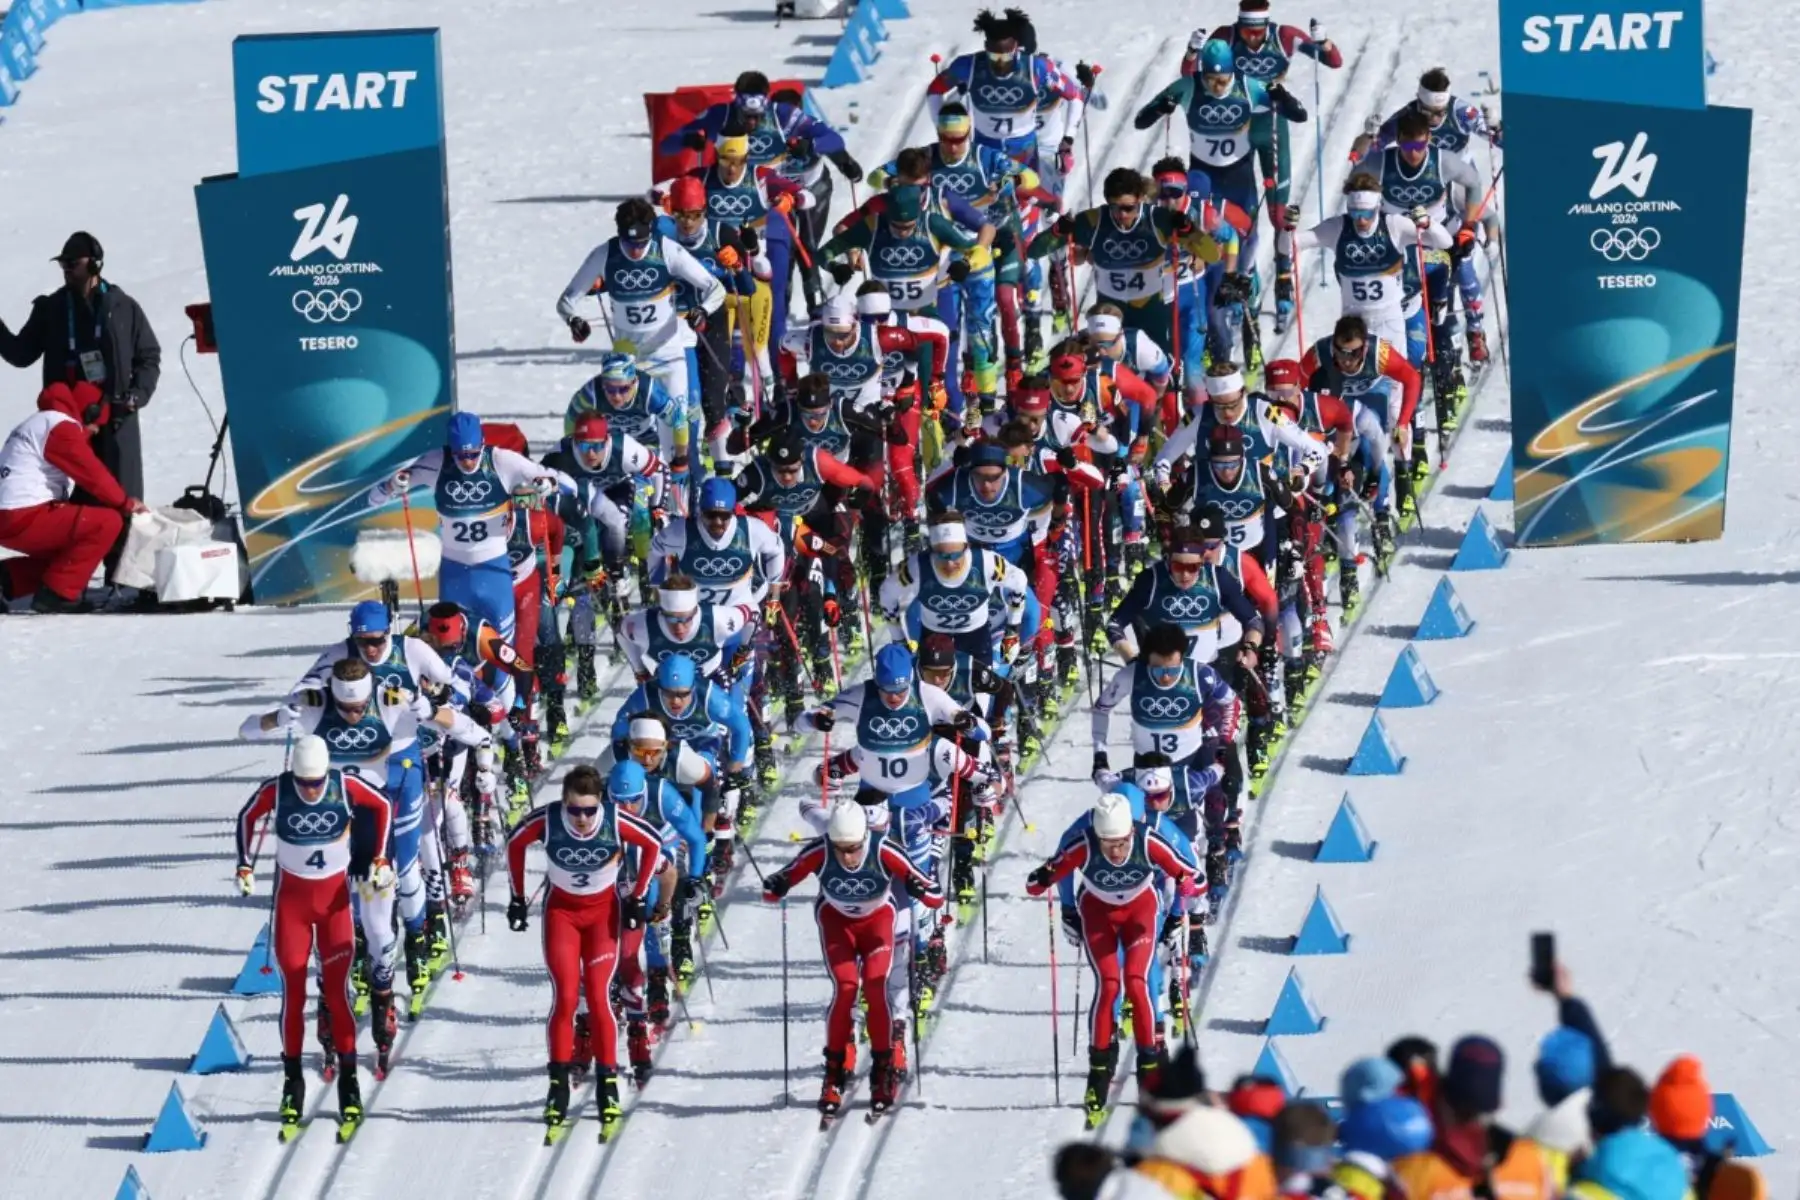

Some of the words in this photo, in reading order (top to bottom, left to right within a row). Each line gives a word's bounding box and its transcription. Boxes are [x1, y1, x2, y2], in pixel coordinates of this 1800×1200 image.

[1521, 11, 1683, 53] START
[256, 71, 417, 114] START
[989, 116, 1013, 133] 71
[1204, 138, 1236, 157] 70
[1567, 203, 1622, 215] MILANO
[1624, 200, 1682, 212] CORTINA
[1611, 213, 1638, 225] 2026
[269, 264, 324, 276] MILANO
[326, 262, 383, 274] CORTINA
[313, 275, 340, 286] 2026
[1109, 271, 1146, 292] 54
[1596, 274, 1657, 289] TESERO
[889, 280, 922, 301] 55
[1352, 280, 1384, 301] 53
[625, 304, 658, 325] 52
[299, 335, 358, 351] TESERO
[452, 521, 488, 542] 28
[700, 587, 733, 606] 27
[936, 613, 970, 629] 22
[1150, 732, 1179, 753] 13
[878, 757, 908, 779] 10
[305, 849, 328, 870] 4
[571, 872, 591, 888] 3
